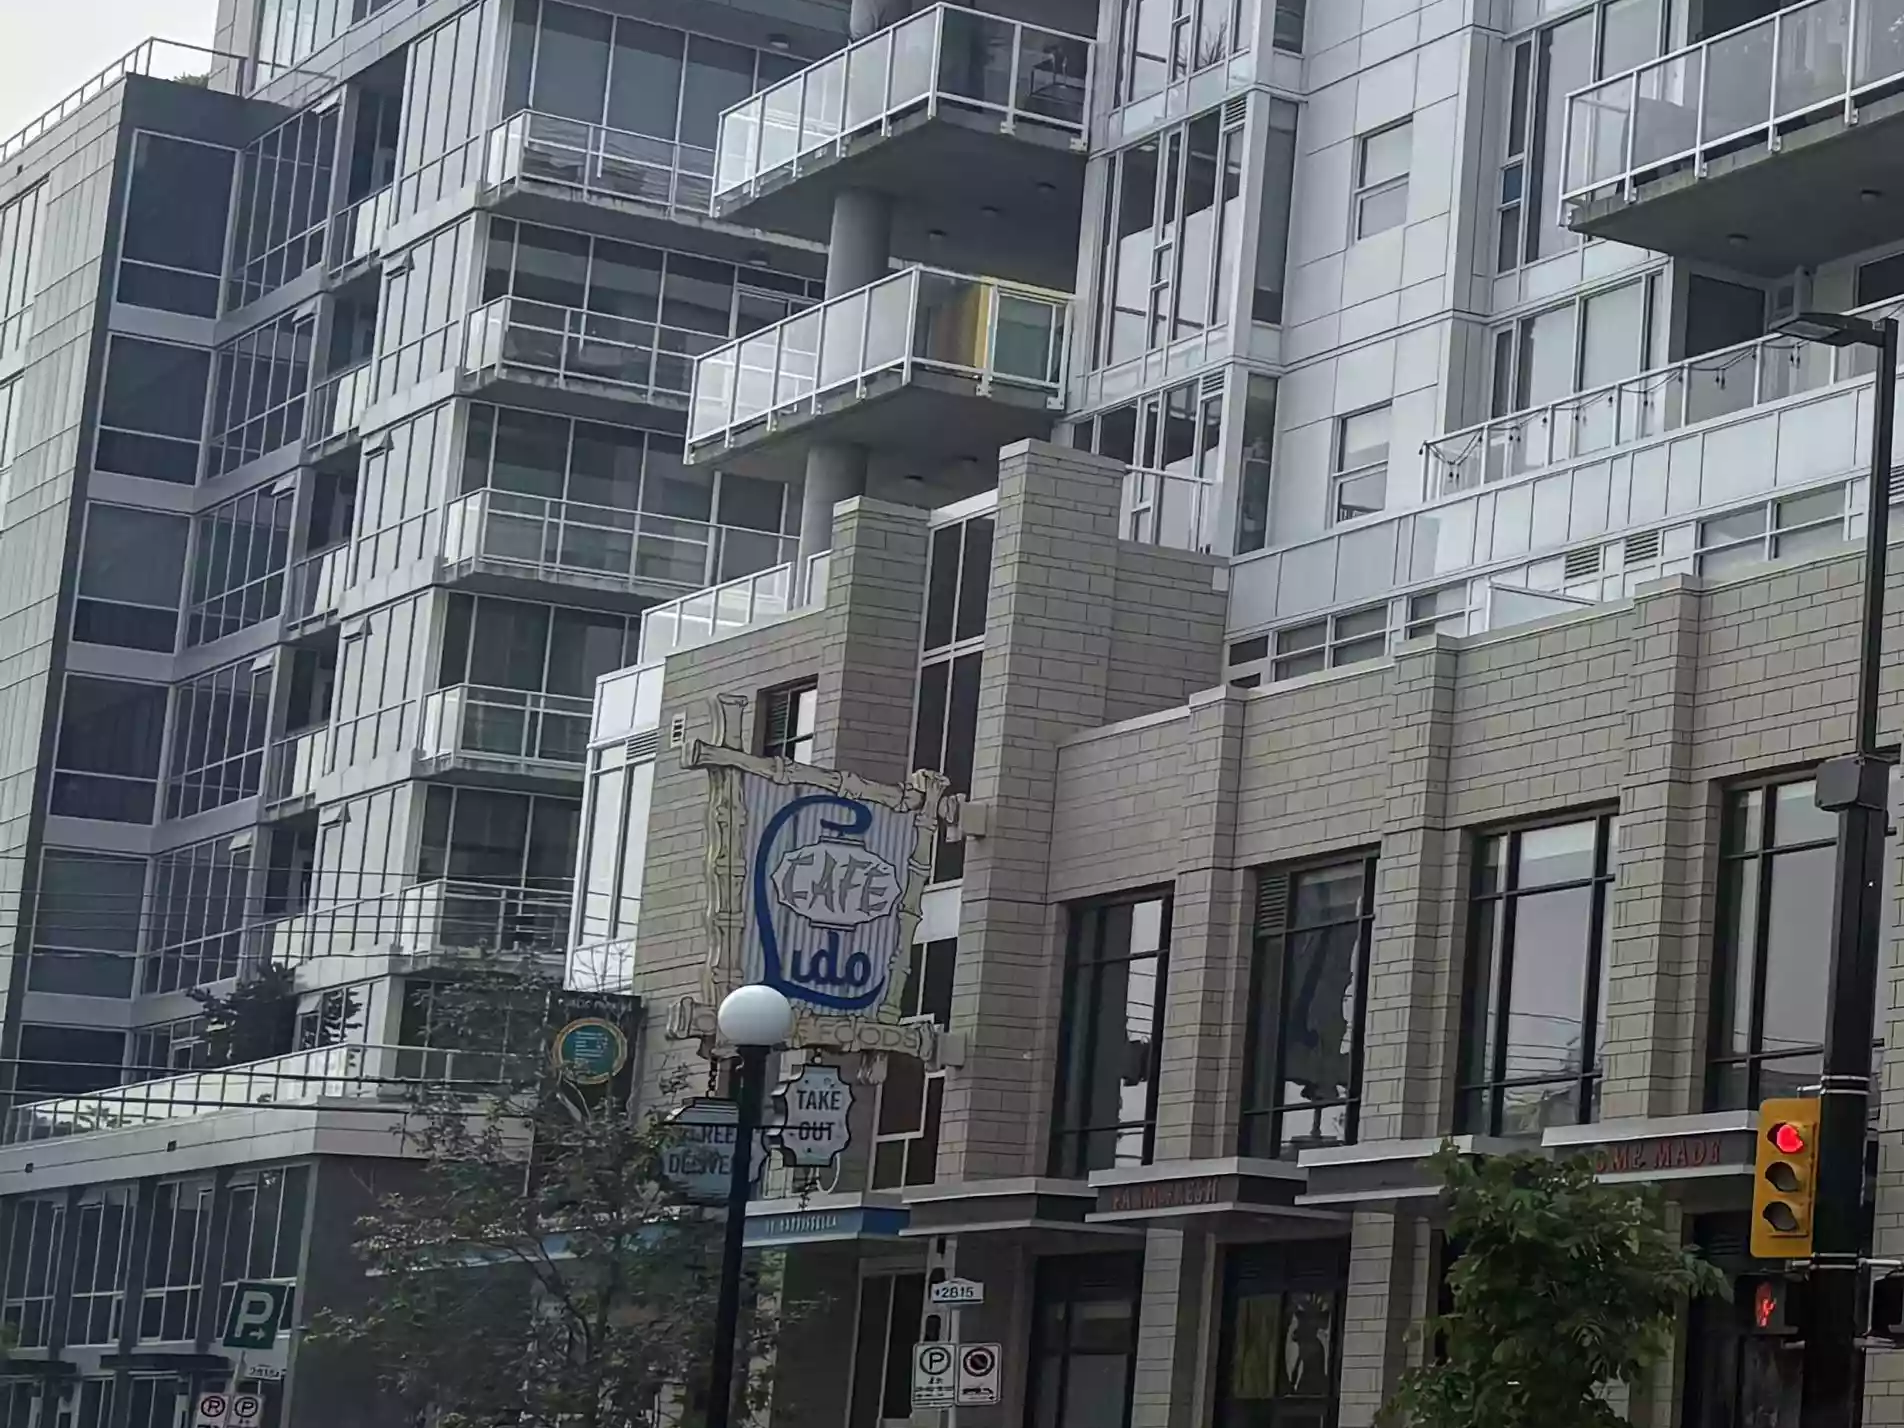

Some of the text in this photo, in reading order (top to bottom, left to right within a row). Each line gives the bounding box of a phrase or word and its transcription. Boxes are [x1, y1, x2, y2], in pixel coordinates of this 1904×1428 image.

[754, 794, 886, 1010] Lido
[797, 1090, 841, 1111] TAKE
[798, 1121, 836, 1141] OUT
[233, 1290, 275, 1338] P
